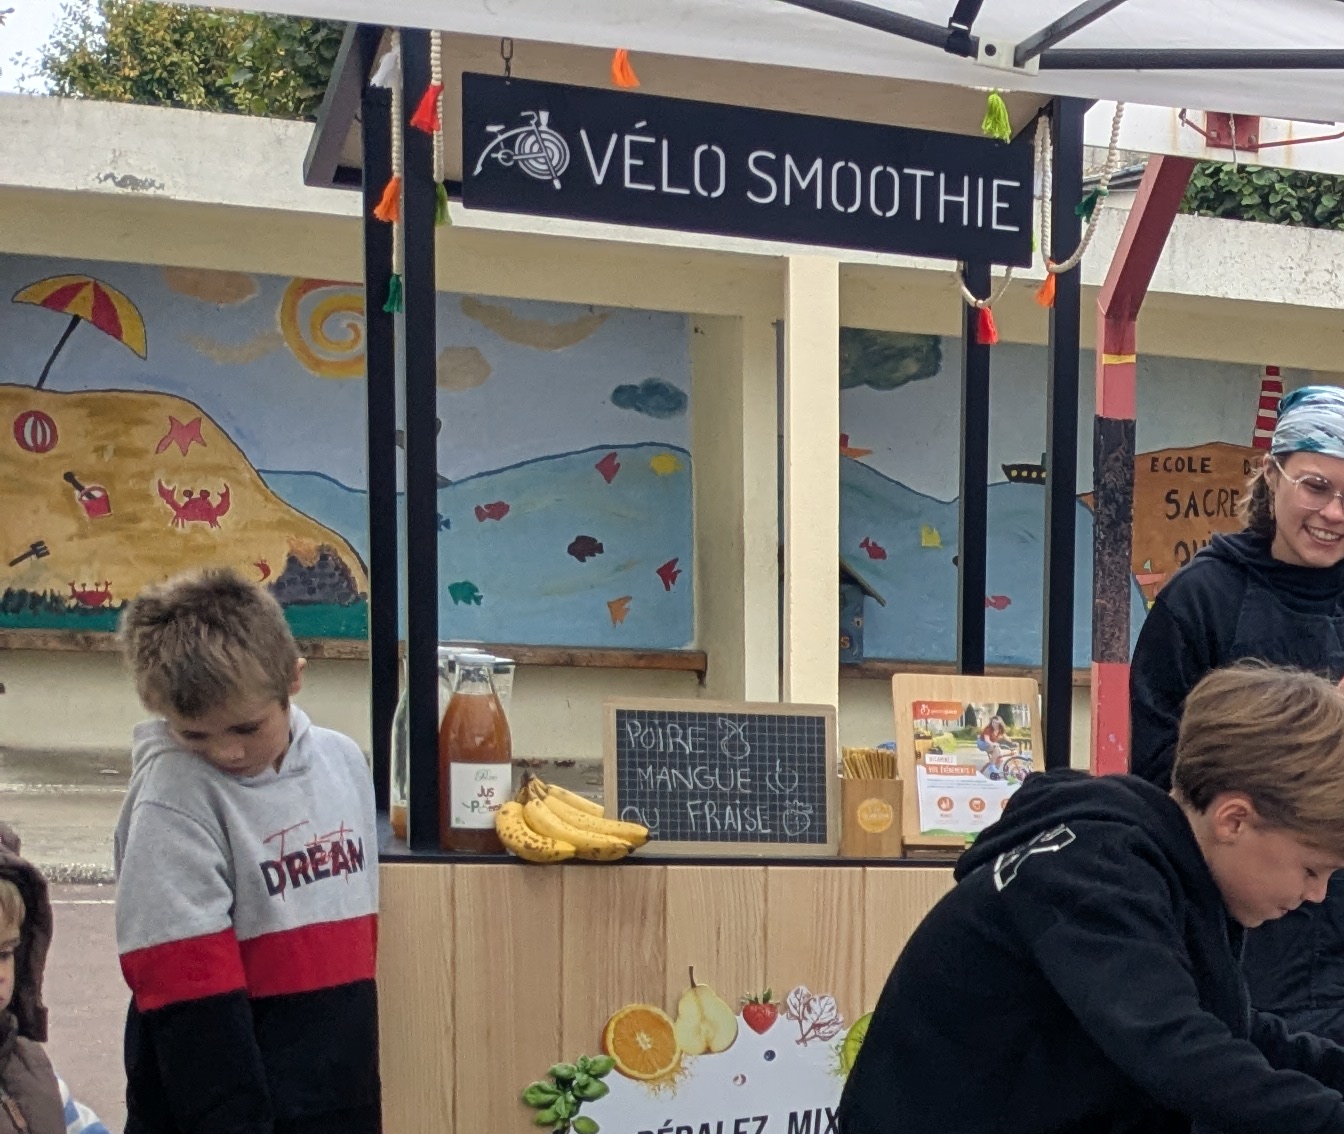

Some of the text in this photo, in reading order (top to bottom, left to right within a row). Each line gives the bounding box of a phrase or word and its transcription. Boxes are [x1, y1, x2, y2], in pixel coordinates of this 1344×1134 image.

[579, 121, 1021, 232] VÉLO SMOOTHIE
[1151, 456, 1212, 474] ECOLE
[1165, 489, 1240, 520] SACRE
[626, 719, 706, 754] POIRE
[636, 765, 751, 794] MANGUE
[686, 800, 771, 833] FRAISE
